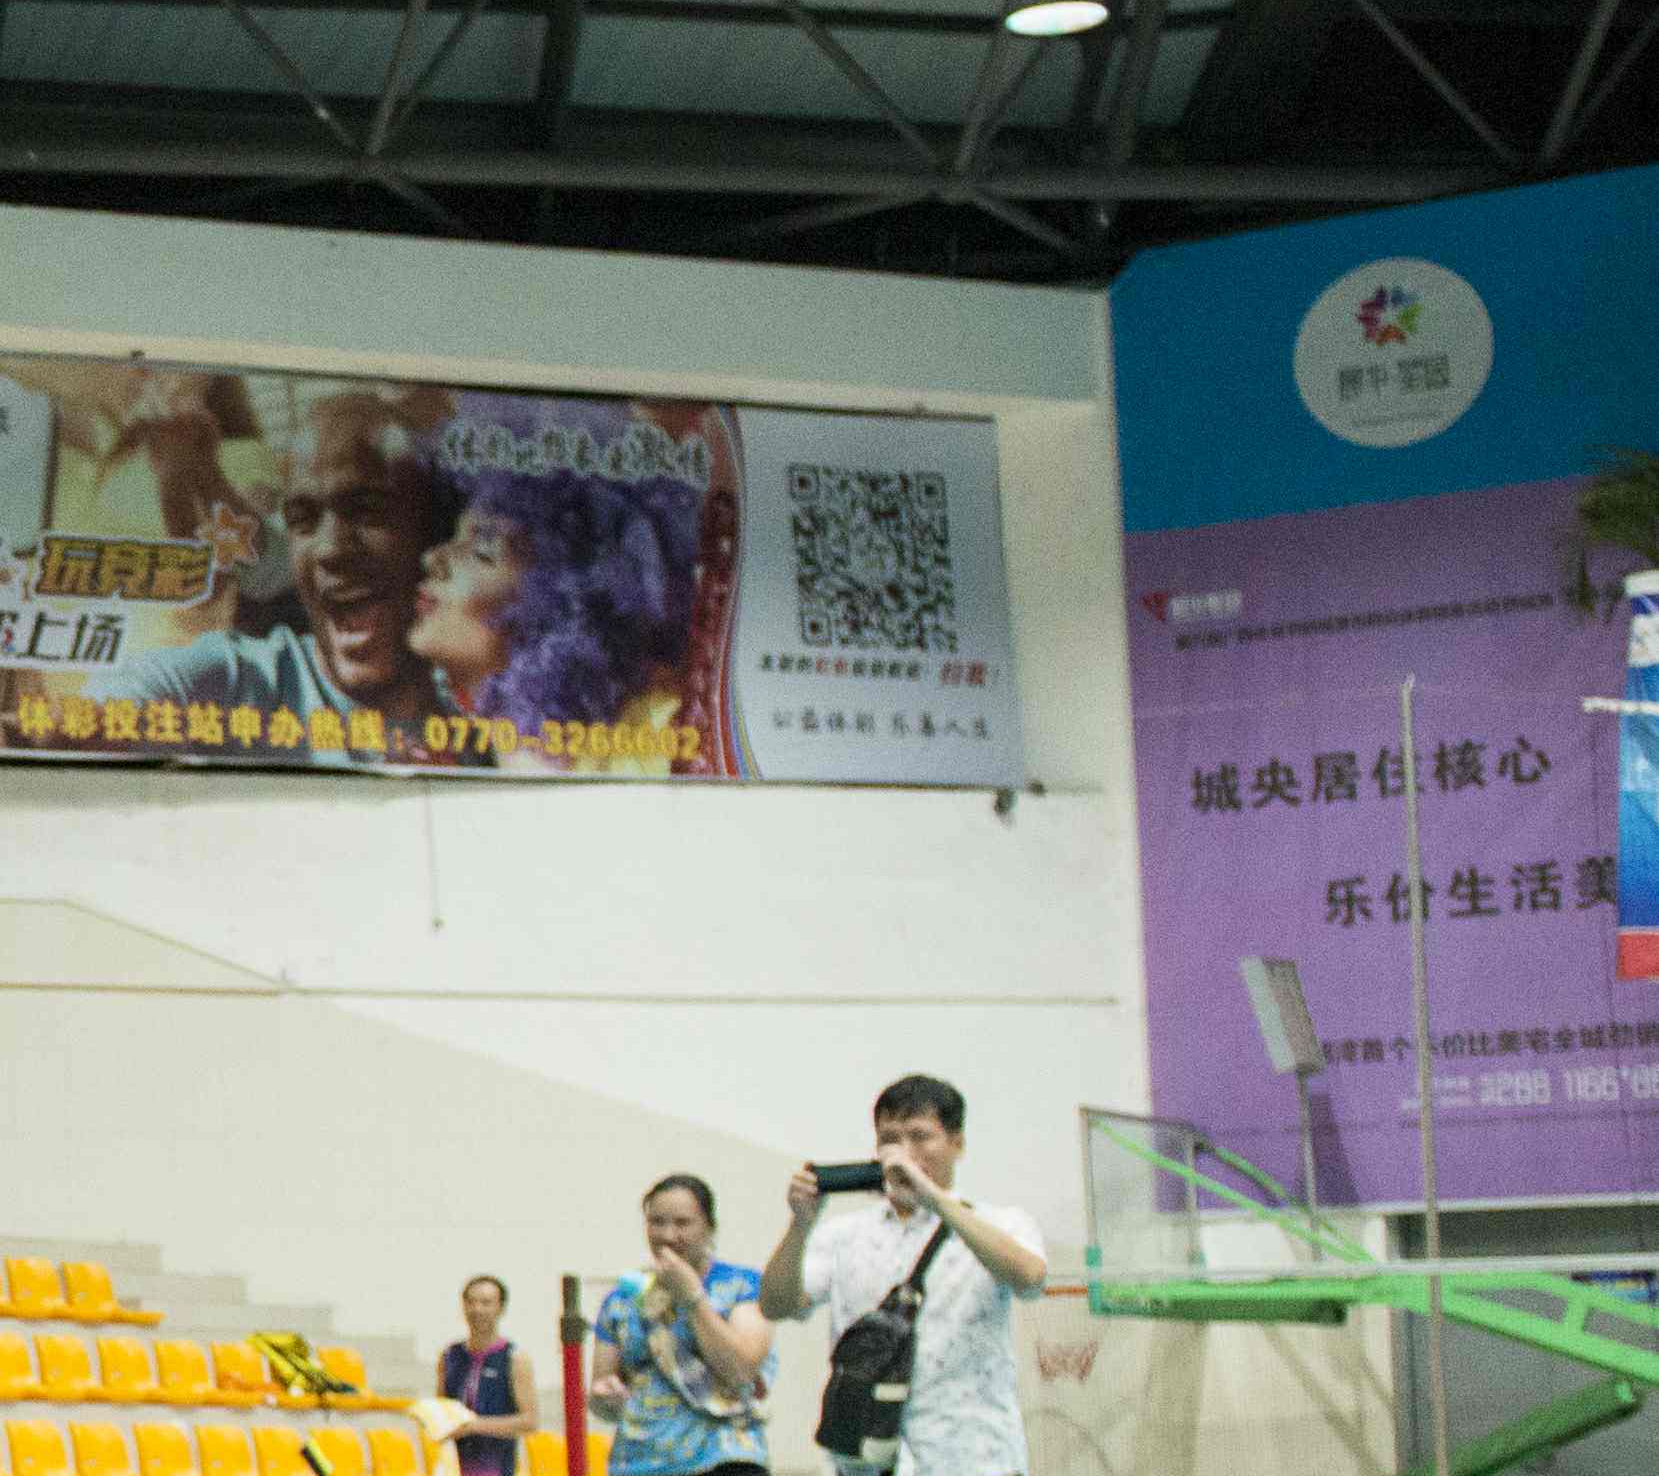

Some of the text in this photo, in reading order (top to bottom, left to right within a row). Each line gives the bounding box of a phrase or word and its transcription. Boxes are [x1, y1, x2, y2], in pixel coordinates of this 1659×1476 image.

[1191, 735, 1552, 813] 城央居住核心
